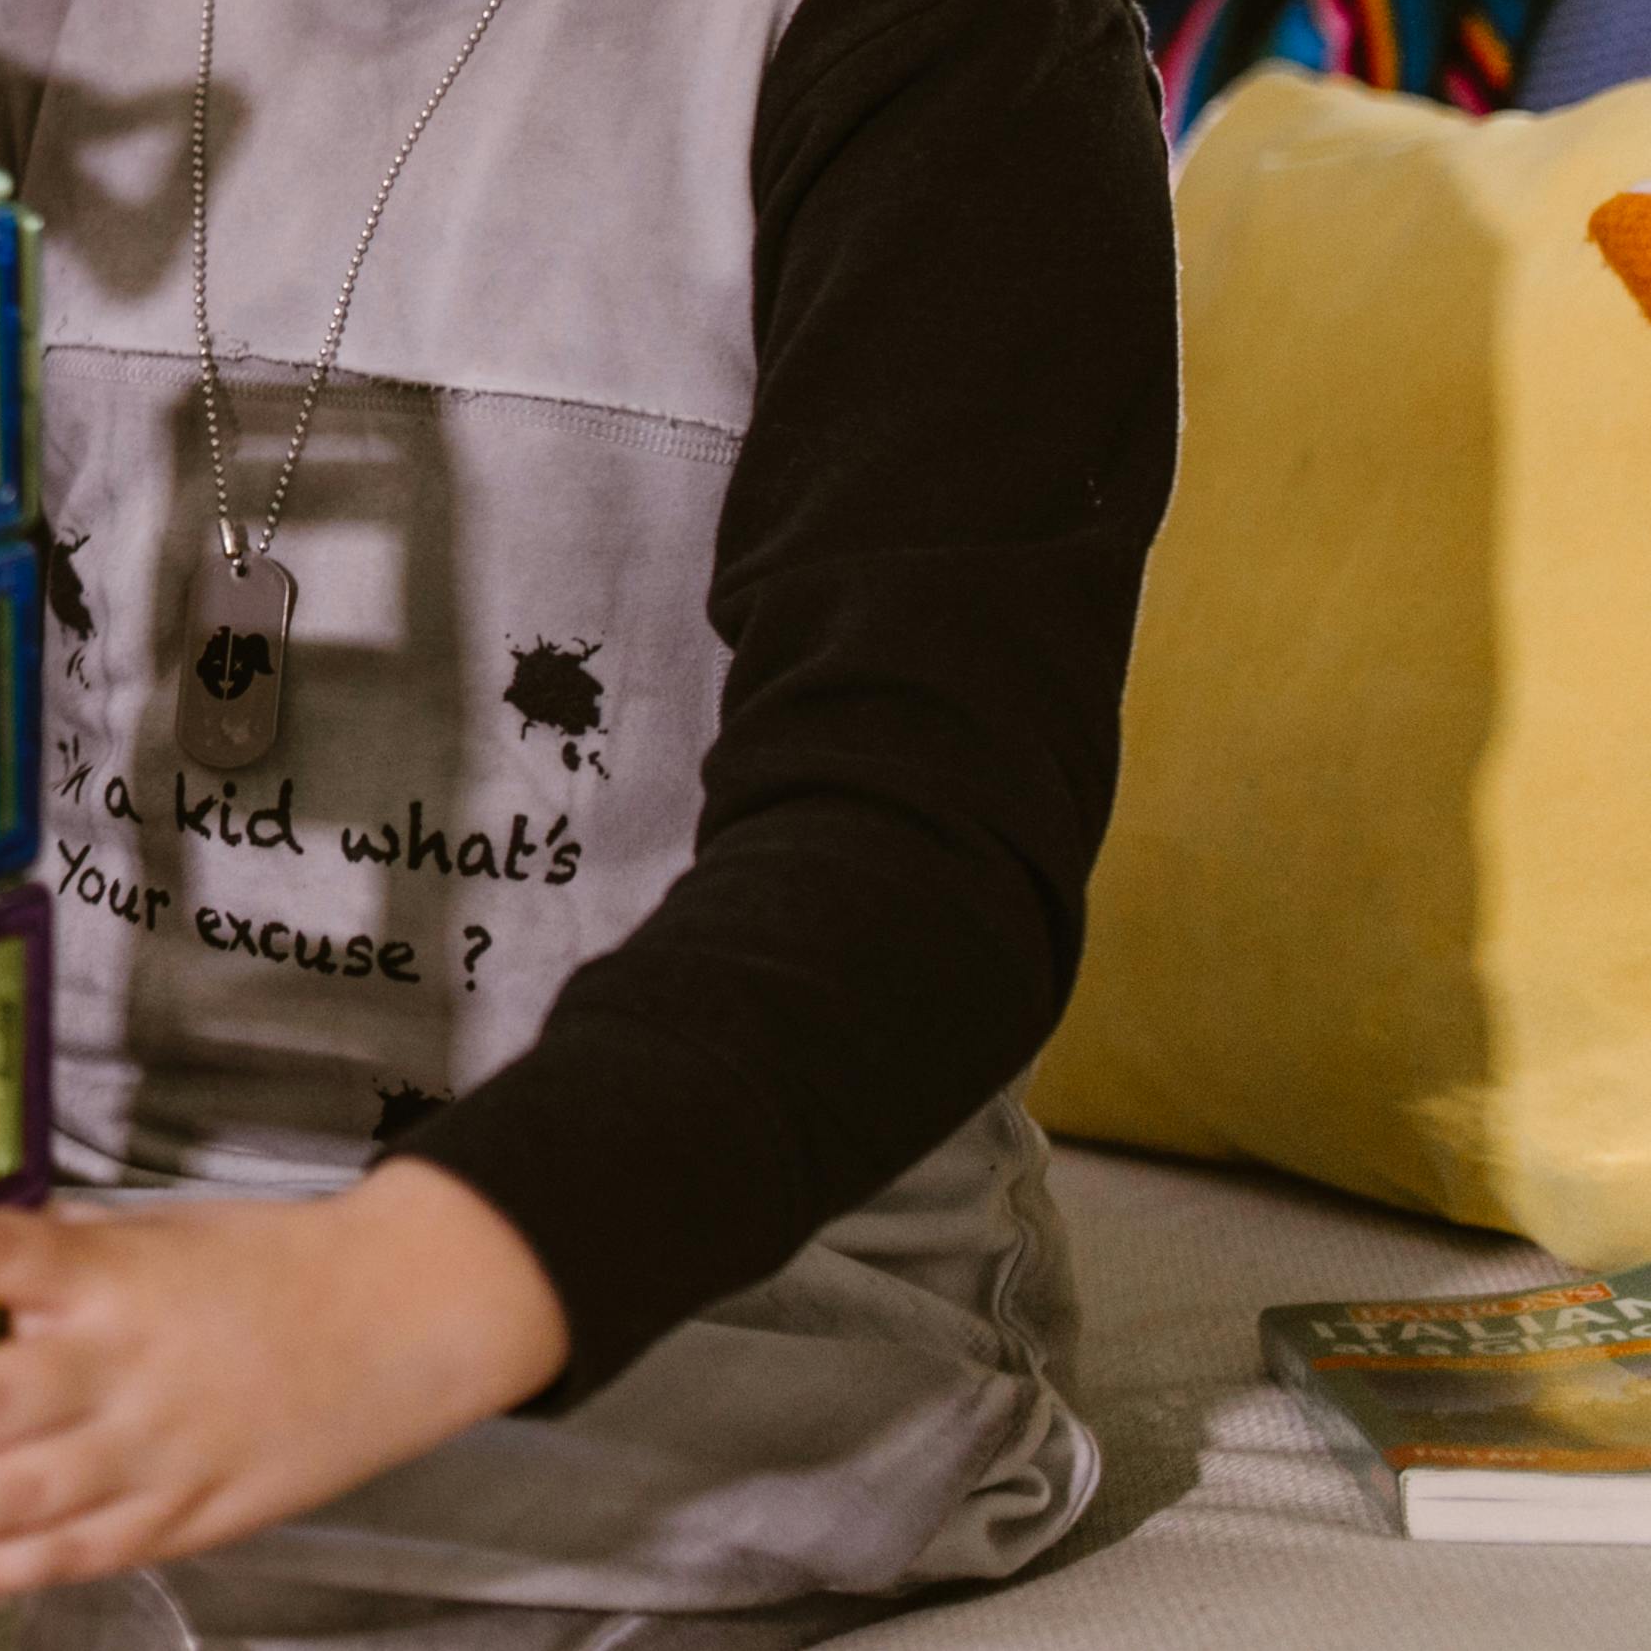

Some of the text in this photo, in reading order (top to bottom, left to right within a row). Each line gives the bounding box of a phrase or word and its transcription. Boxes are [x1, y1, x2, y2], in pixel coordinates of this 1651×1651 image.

[104, 776, 144, 825] a
[174, 771, 305, 856] kid
[341, 800, 583, 887] what's
[195, 907, 421, 984] excuse
[463, 925, 494, 994] ?
